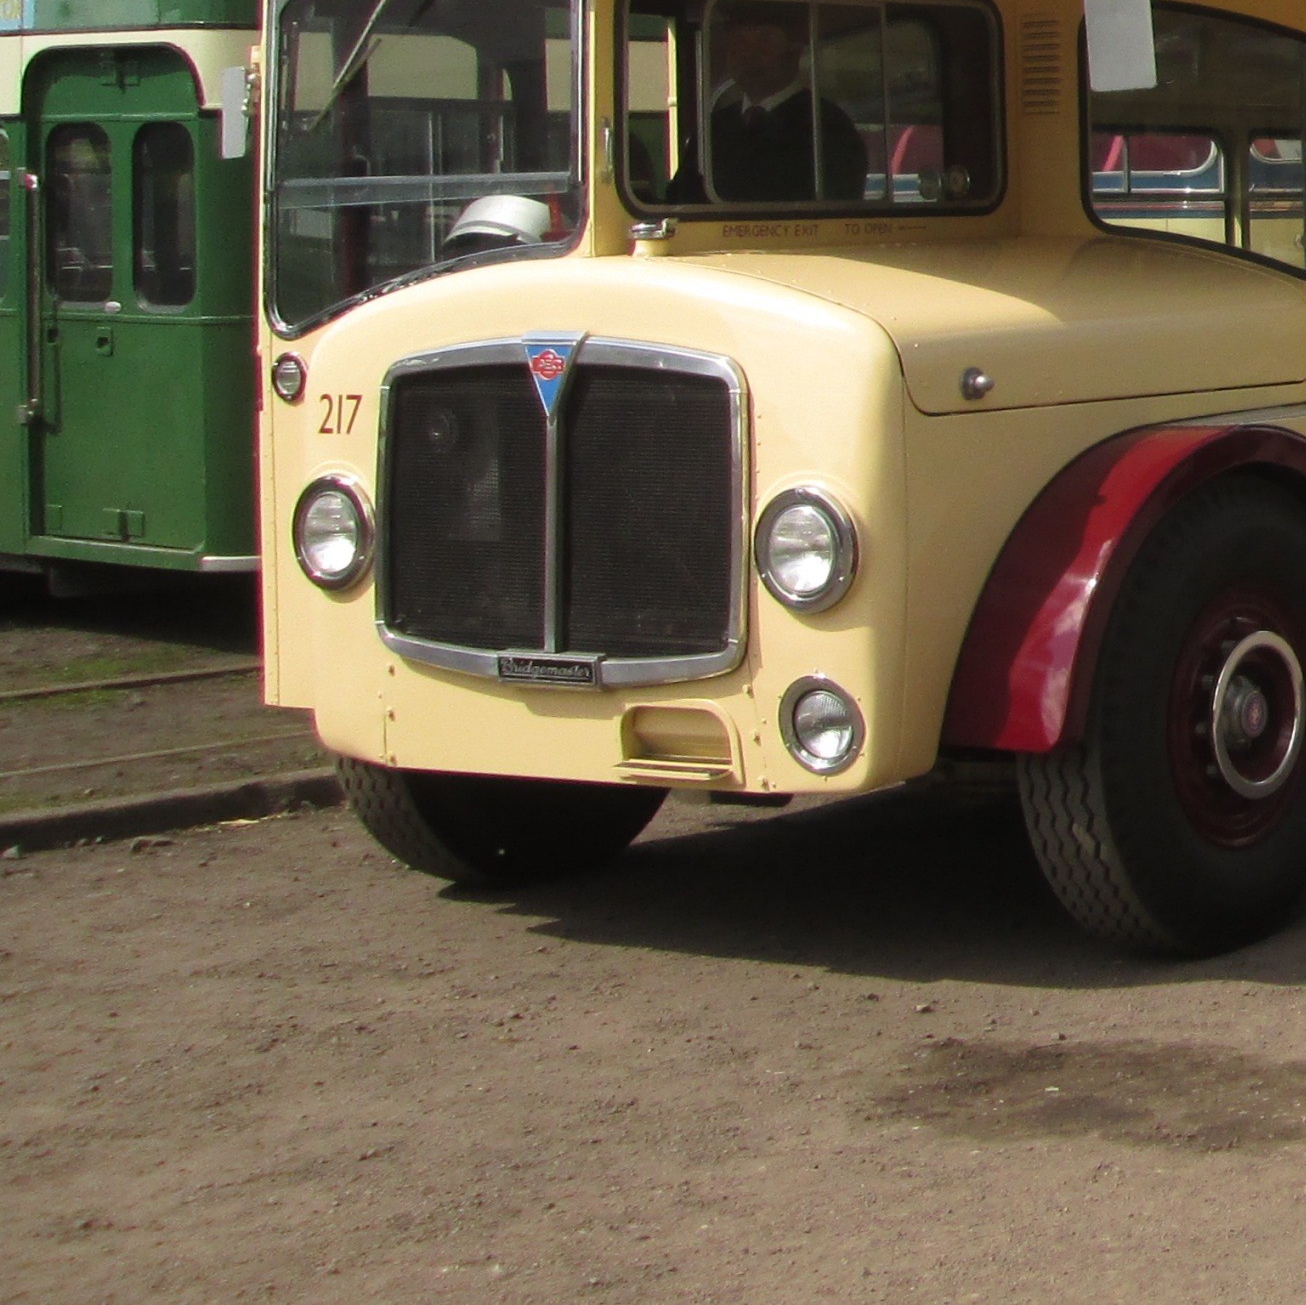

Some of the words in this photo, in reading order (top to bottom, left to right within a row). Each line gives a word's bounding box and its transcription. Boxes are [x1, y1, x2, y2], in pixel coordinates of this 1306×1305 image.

[723, 223, 789, 238] EMERGENCY
[794, 224, 819, 237] EXIT
[844, 223, 860, 235] TO
[318, 394, 363, 435] 217
